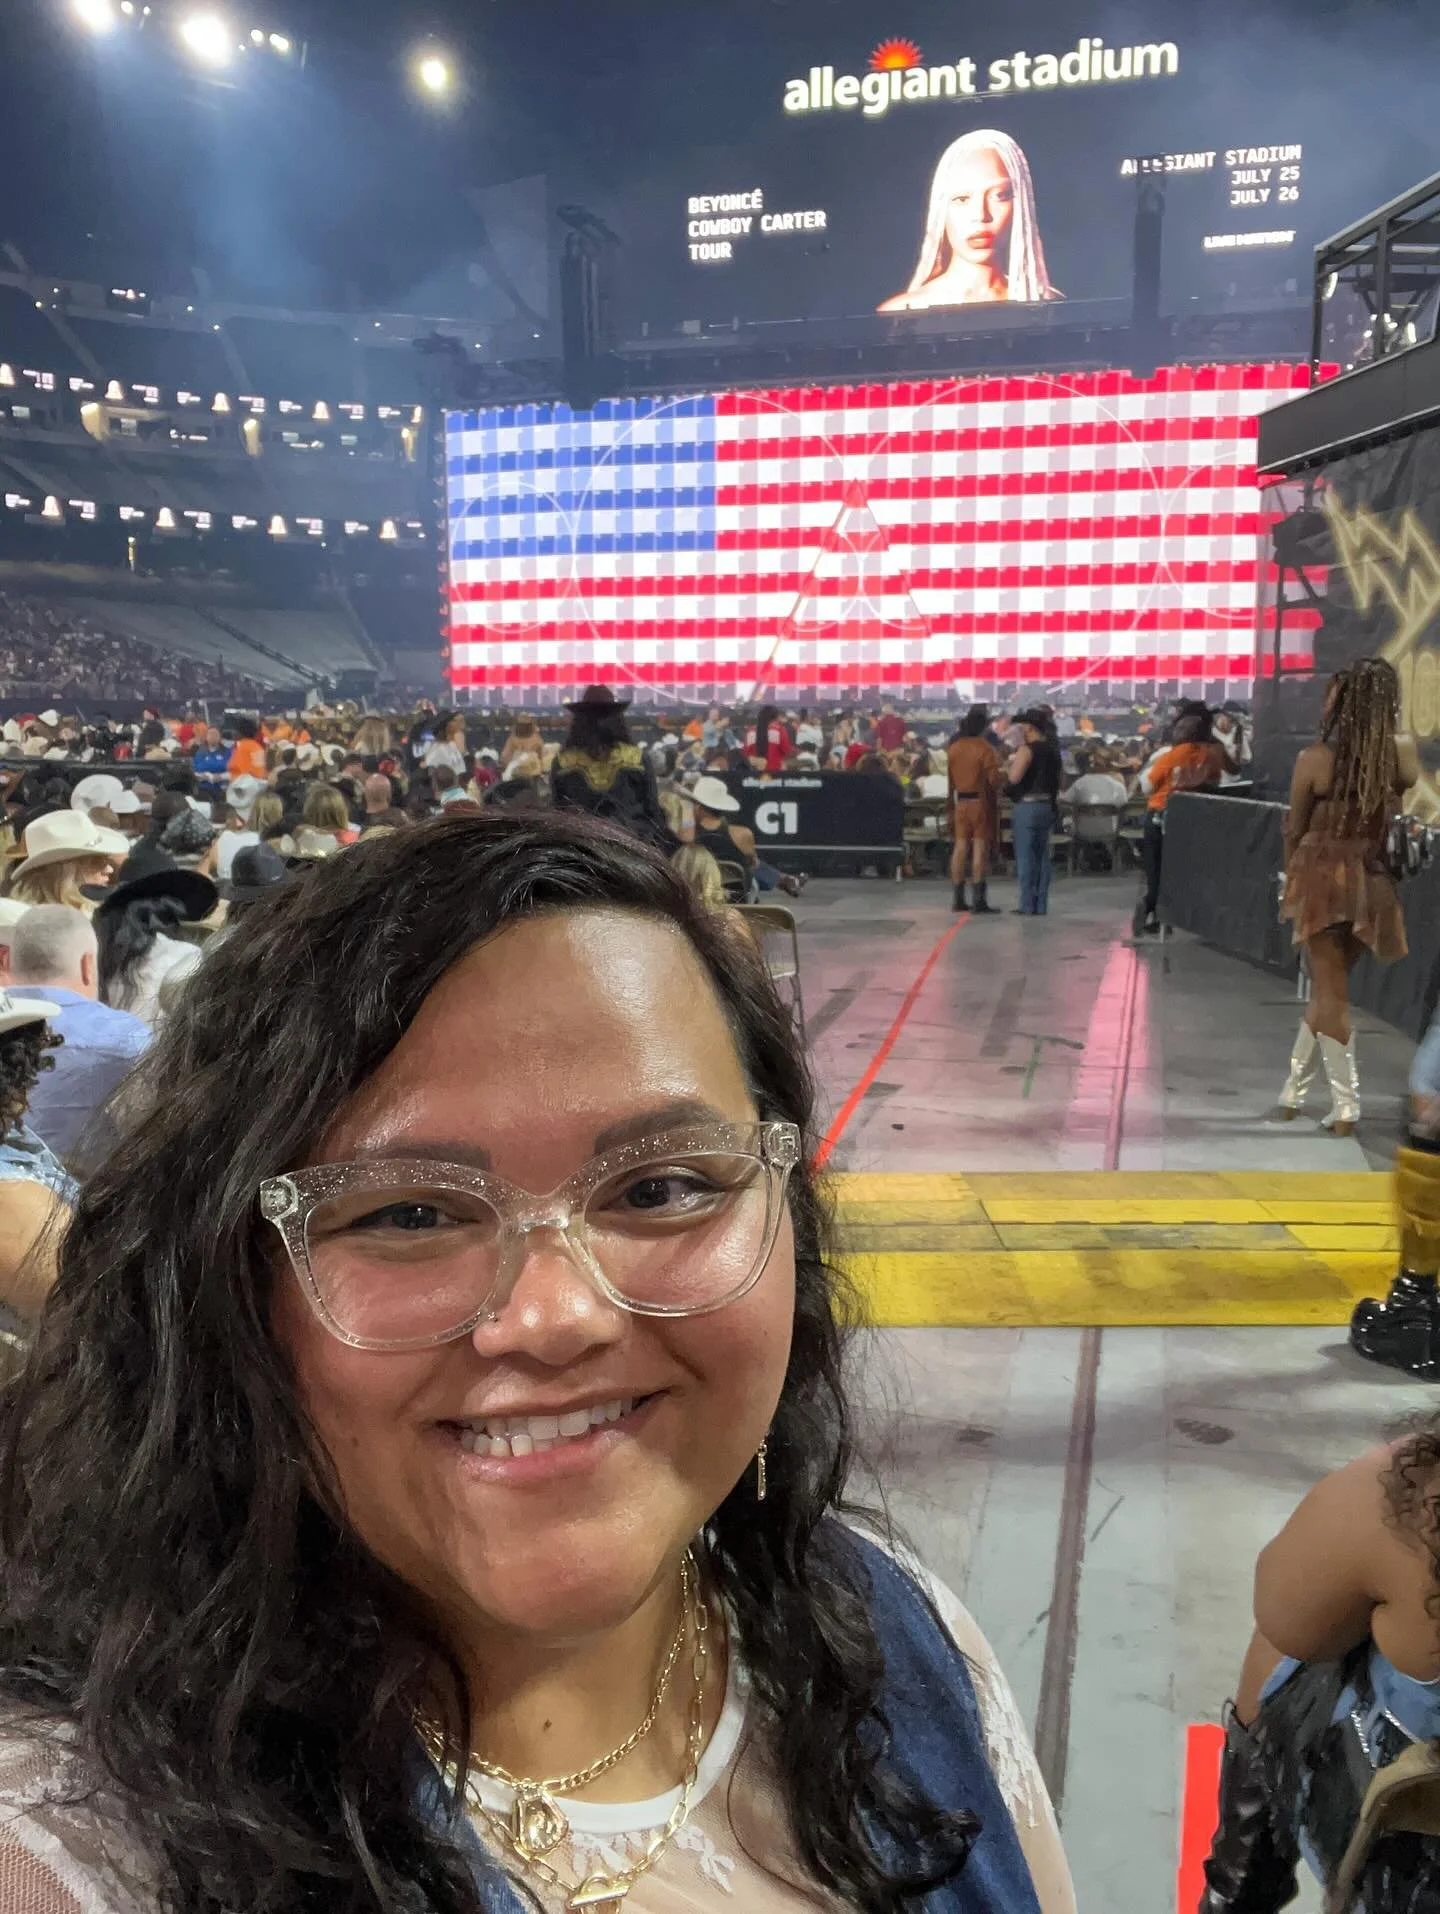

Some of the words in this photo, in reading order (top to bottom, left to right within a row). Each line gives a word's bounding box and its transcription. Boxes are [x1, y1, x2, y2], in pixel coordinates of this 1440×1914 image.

[784, 56, 977, 115] allegiant
[988, 37, 1179, 90] stadium
[1225, 144, 1303, 167] STADIUM
[1231, 168, 1272, 185] JULY
[1279, 166, 1301, 182] 25
[687, 188, 764, 214] BEYONCÉ
[1230, 188, 1272, 205] JULY
[1278, 186, 1300, 202] 26
[687, 216, 753, 238] COWBOY
[760, 210, 827, 232] CARTER
[687, 241, 732, 261] TOUR
[755, 801, 798, 835] C1
